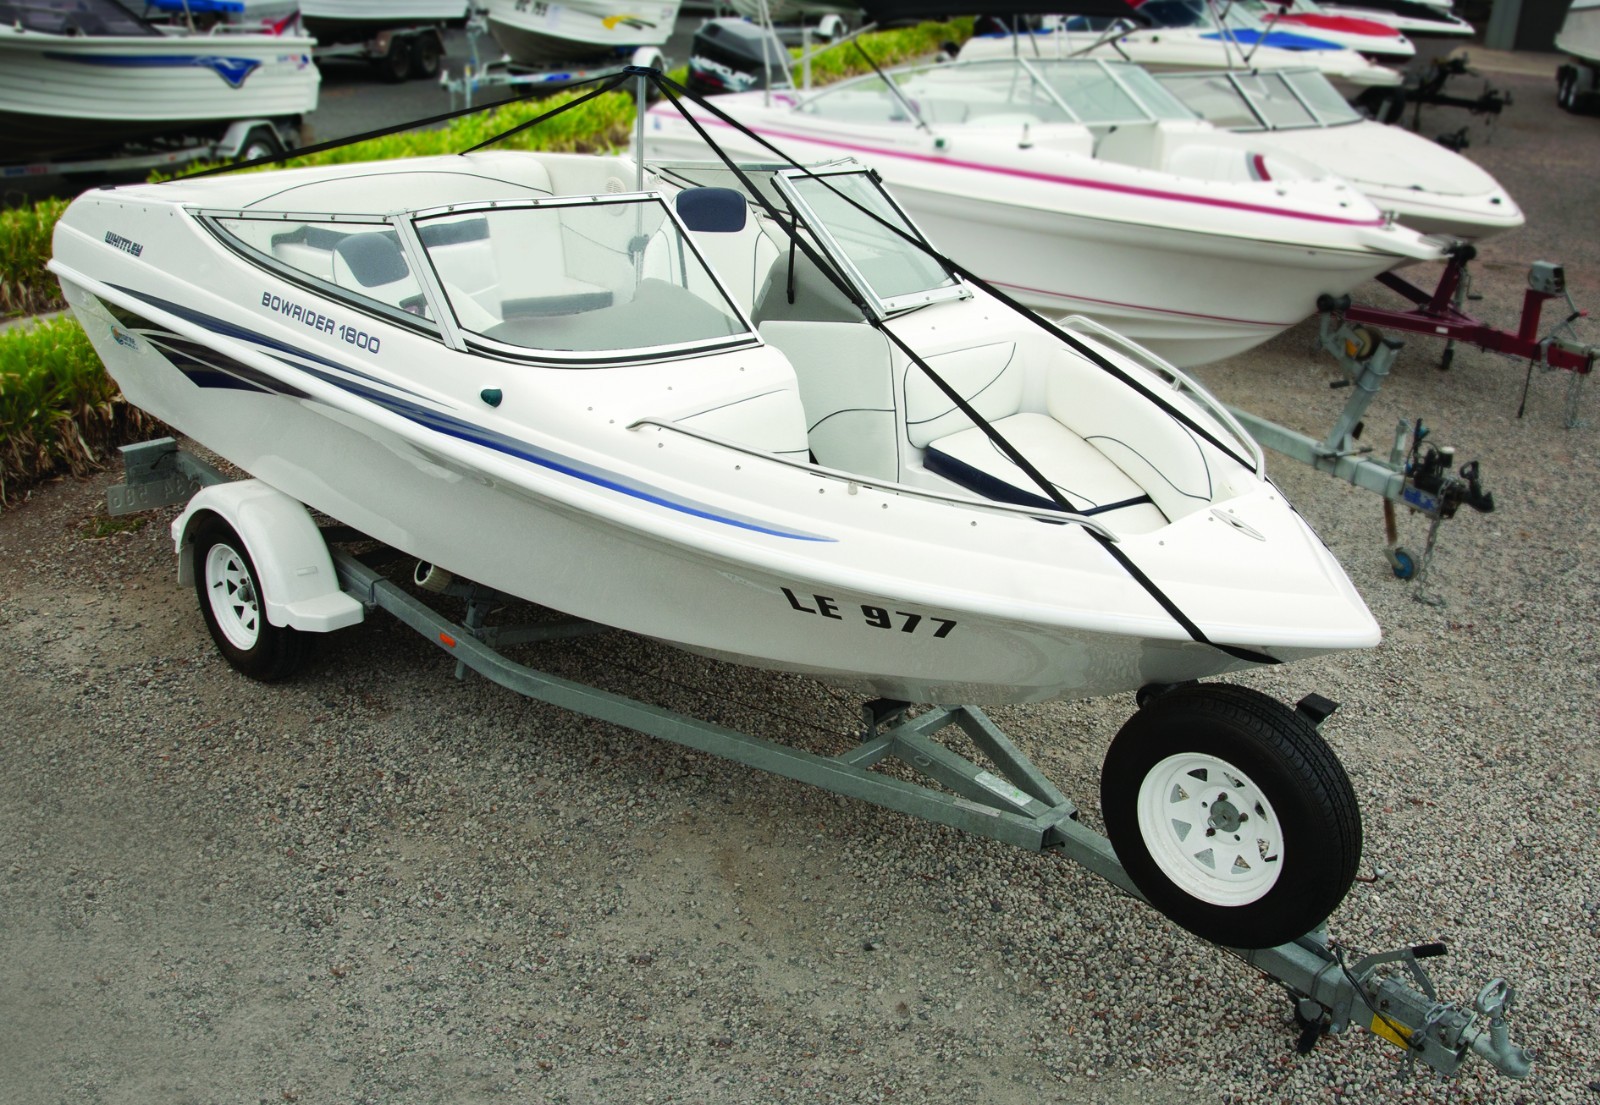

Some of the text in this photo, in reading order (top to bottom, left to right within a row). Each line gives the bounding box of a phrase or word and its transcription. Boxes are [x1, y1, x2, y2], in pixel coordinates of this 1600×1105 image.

[104, 230, 144, 258] WHITTLEY
[261, 291, 381, 354] BOWRIDER 1800
[780, 586, 957, 639] LE 977
